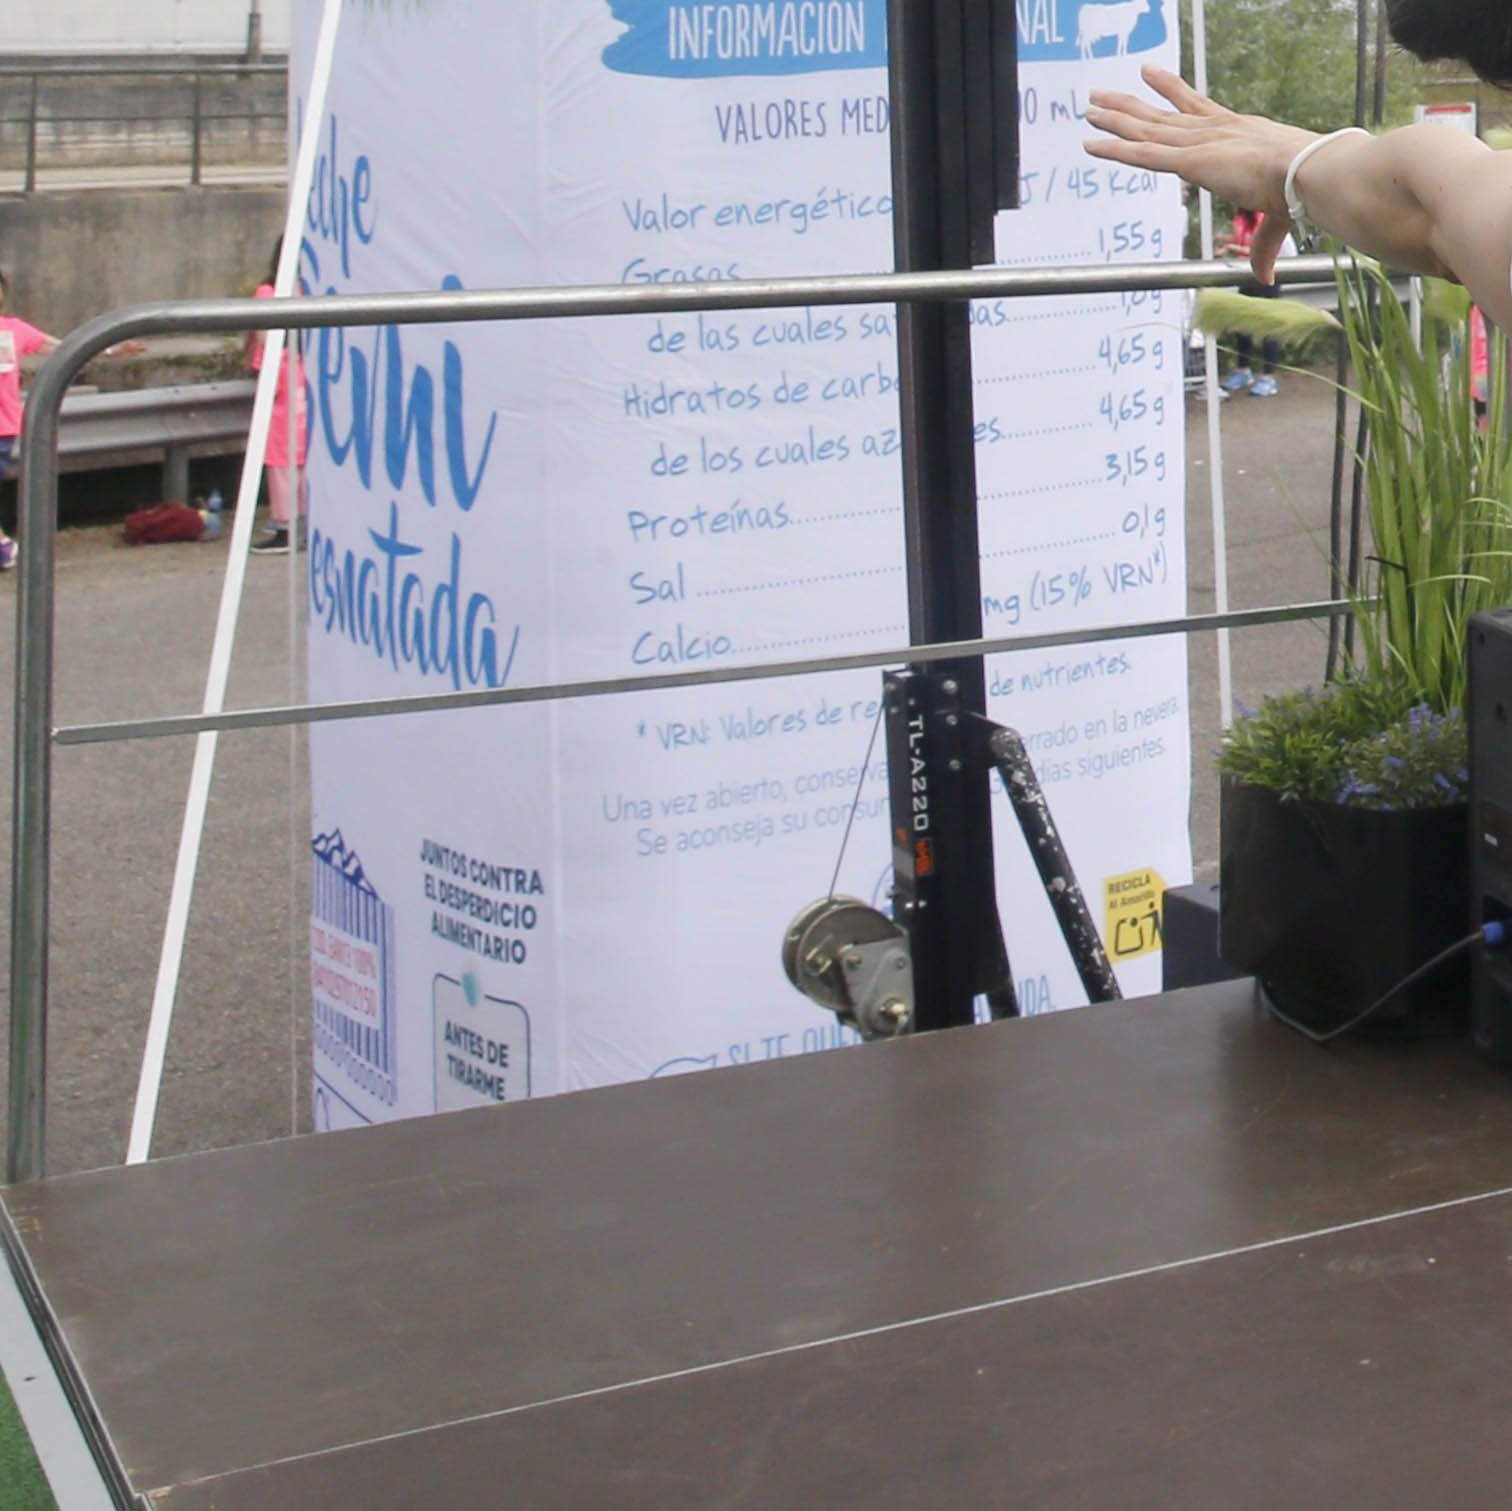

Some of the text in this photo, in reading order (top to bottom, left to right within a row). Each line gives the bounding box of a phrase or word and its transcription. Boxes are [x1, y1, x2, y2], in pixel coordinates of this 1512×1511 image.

[715, 96, 891, 145] VALORES MED
[1067, 167, 1099, 200] 45
[622, 186, 894, 235] Valor energético
[1099, 220, 1163, 262] 1,55 g
[647, 319, 686, 354] de
[698, 312, 740, 353] las
[751, 304, 848, 348] cuales
[1098, 334, 1164, 375] 4,65 g
[623, 380, 762, 419] Hidratos
[773, 370, 809, 405] de
[1099, 389, 1165, 432] 4,65 g
[650, 442, 689, 476] de
[701, 435, 743, 474] los
[755, 425, 850, 469] cuales
[1105, 445, 1166, 486] 3,15 g
[627, 497, 791, 541] Proteínas
[1122, 503, 1166, 539] 0,1 g
[309, 500, 520, 691] esnatada
[629, 561, 685, 605] Sal
[983, 594, 1021, 625] mg
[1029, 565, 1093, 612] (15%
[631, 623, 731, 665] Calcio
[989, 668, 1013, 697] de
[719, 704, 806, 742] Valores
[815, 697, 842, 727] de
[1084, 718, 1107, 741] en
[1112, 709, 1128, 734] la
[908, 714, 929, 832] TL-A220
[602, 792, 653, 823] Una
[660, 793, 697, 817] vez
[706, 777, 787, 811] abierto,
[637, 827, 667, 857] Se
[676, 815, 775, 849] aconseja
[781, 813, 806, 834] su
[420, 838, 544, 895] JUNTOS CONTRA
[1108, 873, 1151, 896] RECICLA
[424, 873, 537, 931] EL DESPERDICIO
[431, 910, 527, 965] ALIMENTARIO
[444, 1020, 509, 1069] ANTES DE
[446, 1053, 505, 1101] TIRARME
